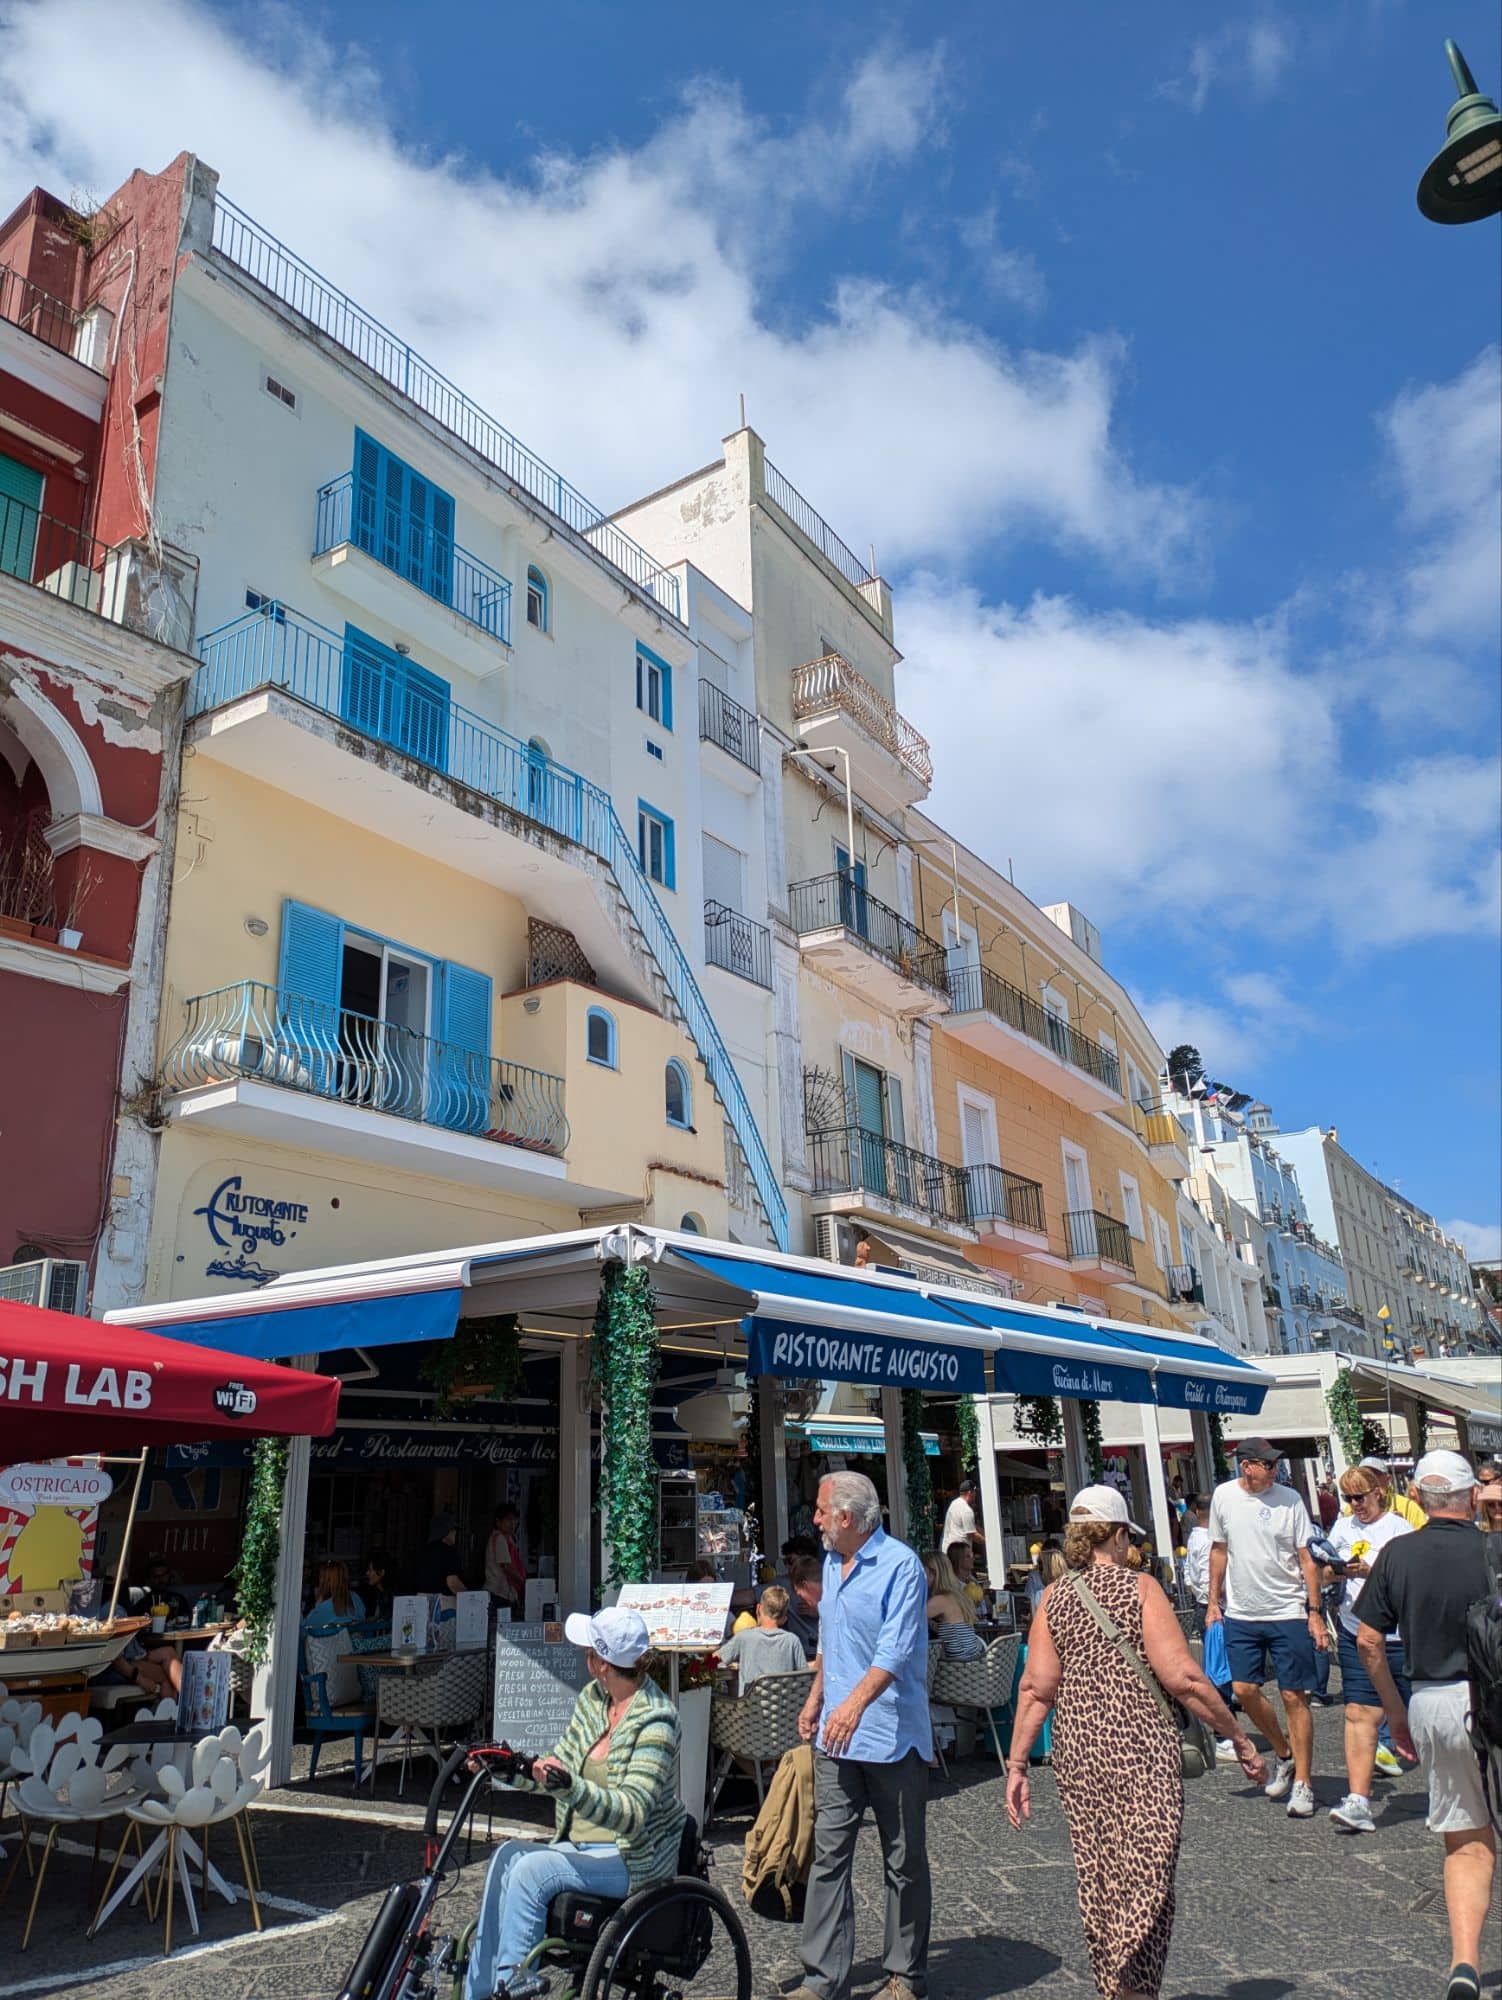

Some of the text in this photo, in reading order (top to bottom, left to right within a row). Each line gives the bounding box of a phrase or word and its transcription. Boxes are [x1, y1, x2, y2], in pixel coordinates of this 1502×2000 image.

[226, 1192, 309, 1223] RISTORANTE
[772, 1332, 960, 1383] RISTORANTE AUGUSTO
[64, 1363, 153, 1410] LAB
[10, 1476, 100, 1494] OSTRICAIO
[498, 1684, 527, 1695] FRESH
